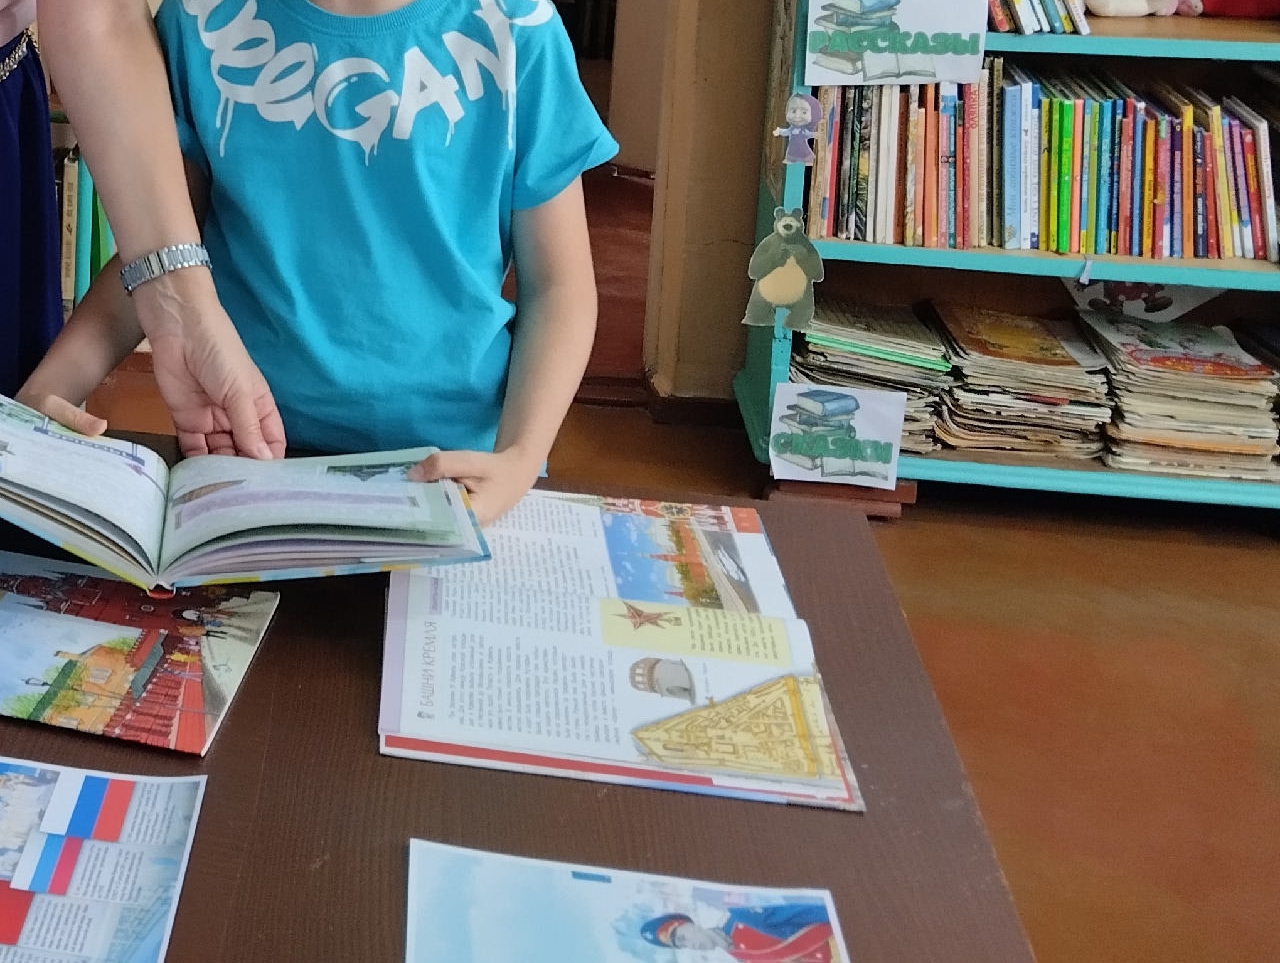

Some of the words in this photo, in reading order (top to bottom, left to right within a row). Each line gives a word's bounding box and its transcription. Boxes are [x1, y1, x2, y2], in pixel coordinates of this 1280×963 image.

[808, 30, 981, 56] РАССКАЗЫ
[421, 621, 438, 666] КРЕМЛЯ
[420, 668, 436, 707] БАШНИ
